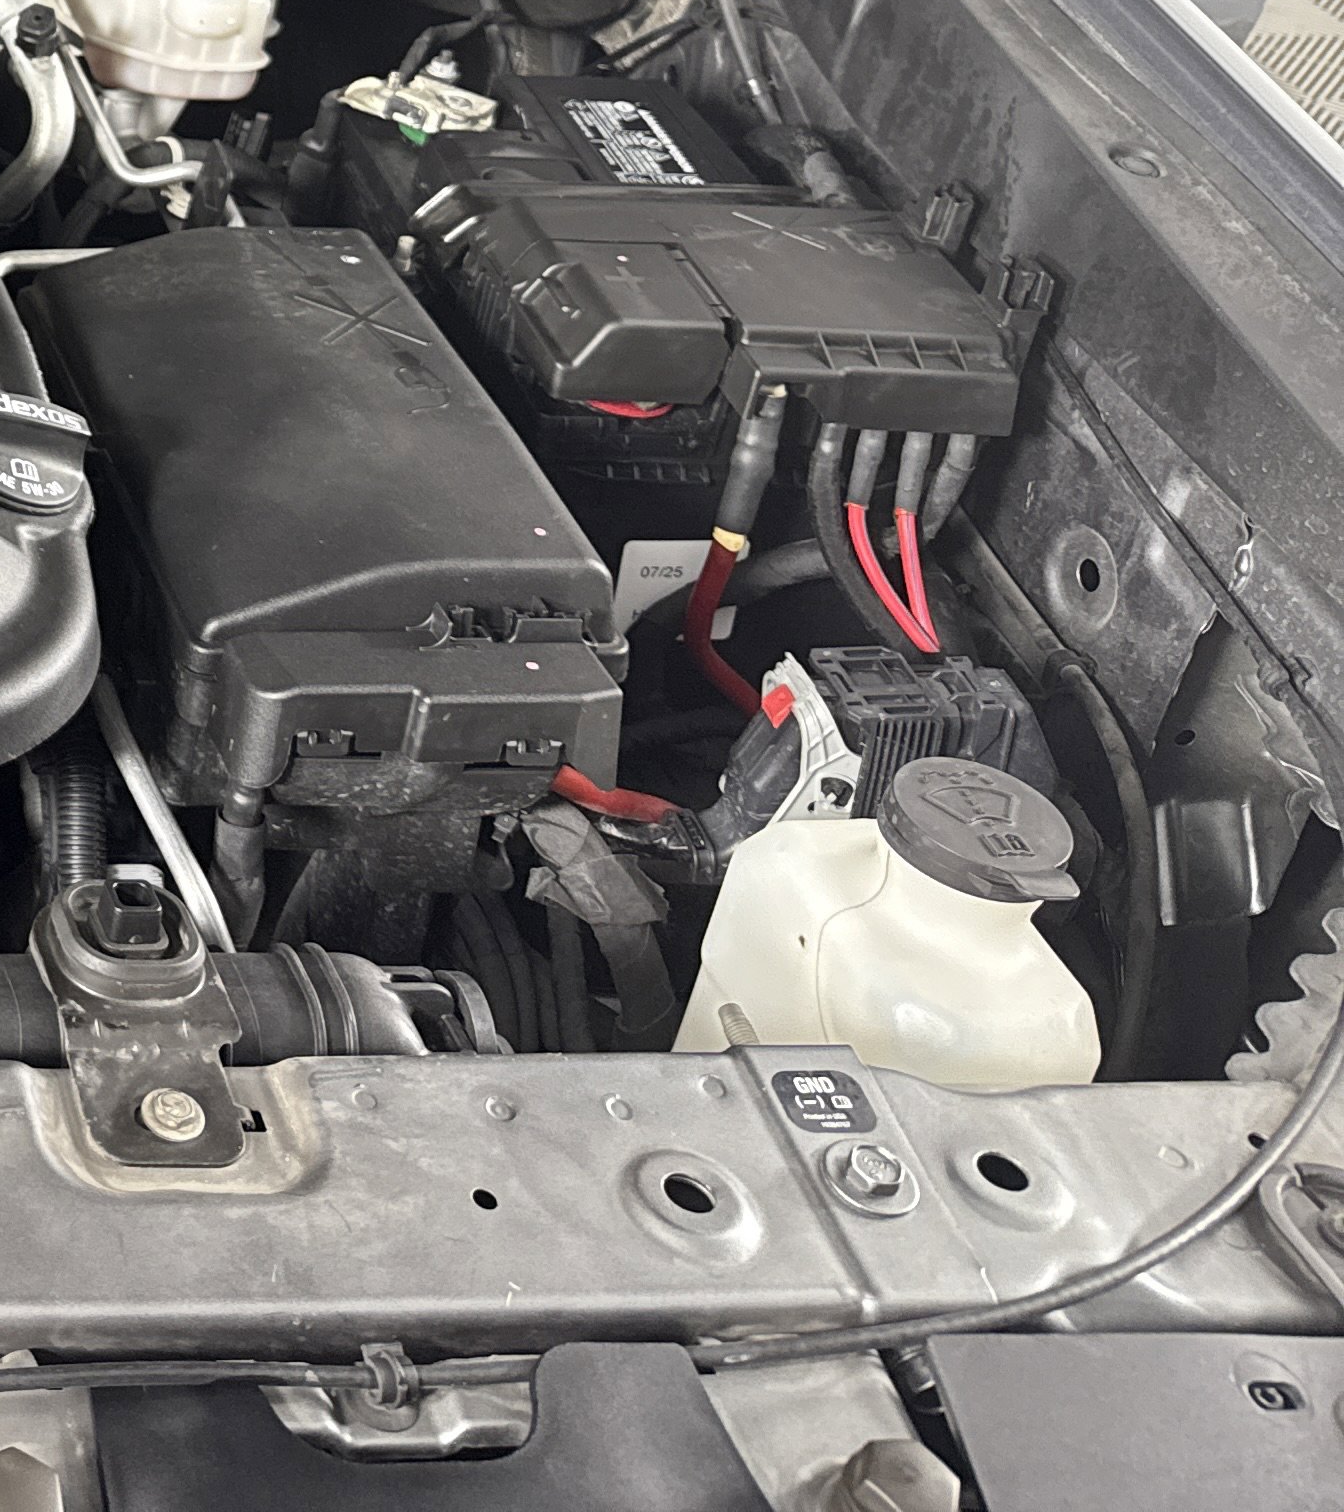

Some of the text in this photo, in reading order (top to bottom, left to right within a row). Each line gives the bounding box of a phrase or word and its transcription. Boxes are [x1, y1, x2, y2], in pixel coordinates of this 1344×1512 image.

[21, 479, 64, 497] 5W-30
[640, 565, 683, 578] 07/25
[793, 1076, 835, 1094] GND
